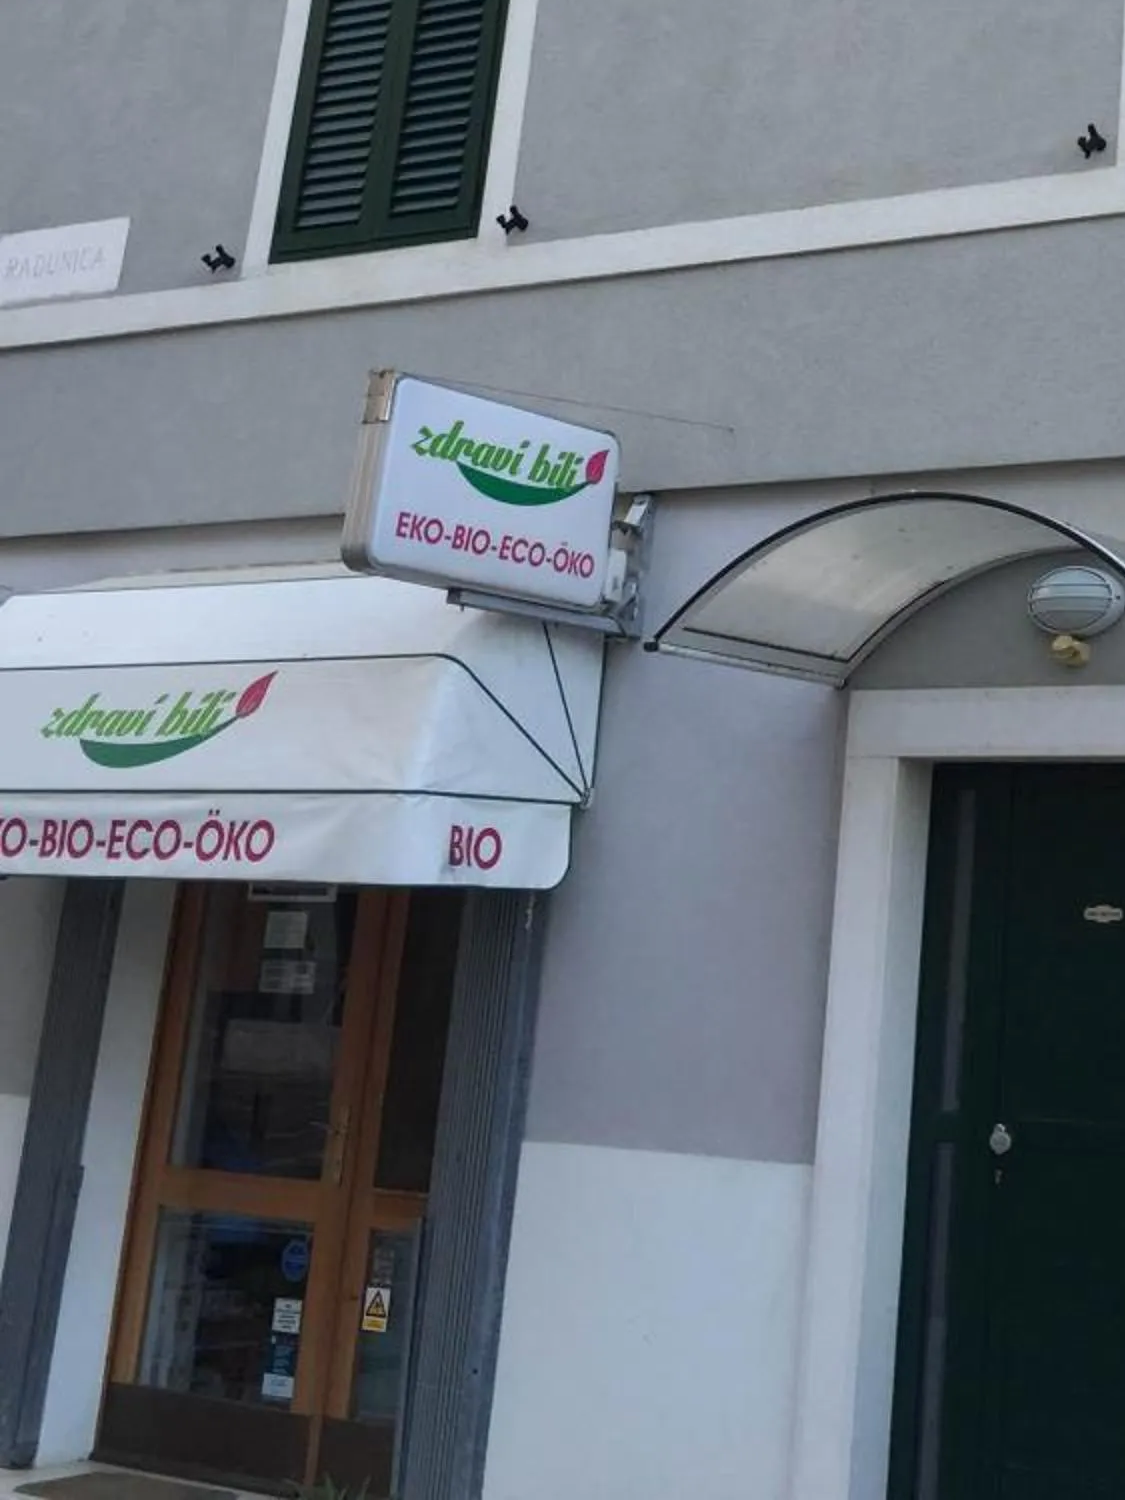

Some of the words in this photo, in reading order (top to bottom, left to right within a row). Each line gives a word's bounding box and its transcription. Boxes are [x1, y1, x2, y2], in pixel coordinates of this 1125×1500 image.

[411, 420, 530, 476] zdravi
[395, 511, 595, 579] EKO-BIO-ECO-ÖKO
[41, 692, 169, 737] zdravi
[155, 690, 236, 736] biti
[0, 809, 275, 862] O-BIO-ECO-ÖKO
[448, 825, 502, 870] BIO
